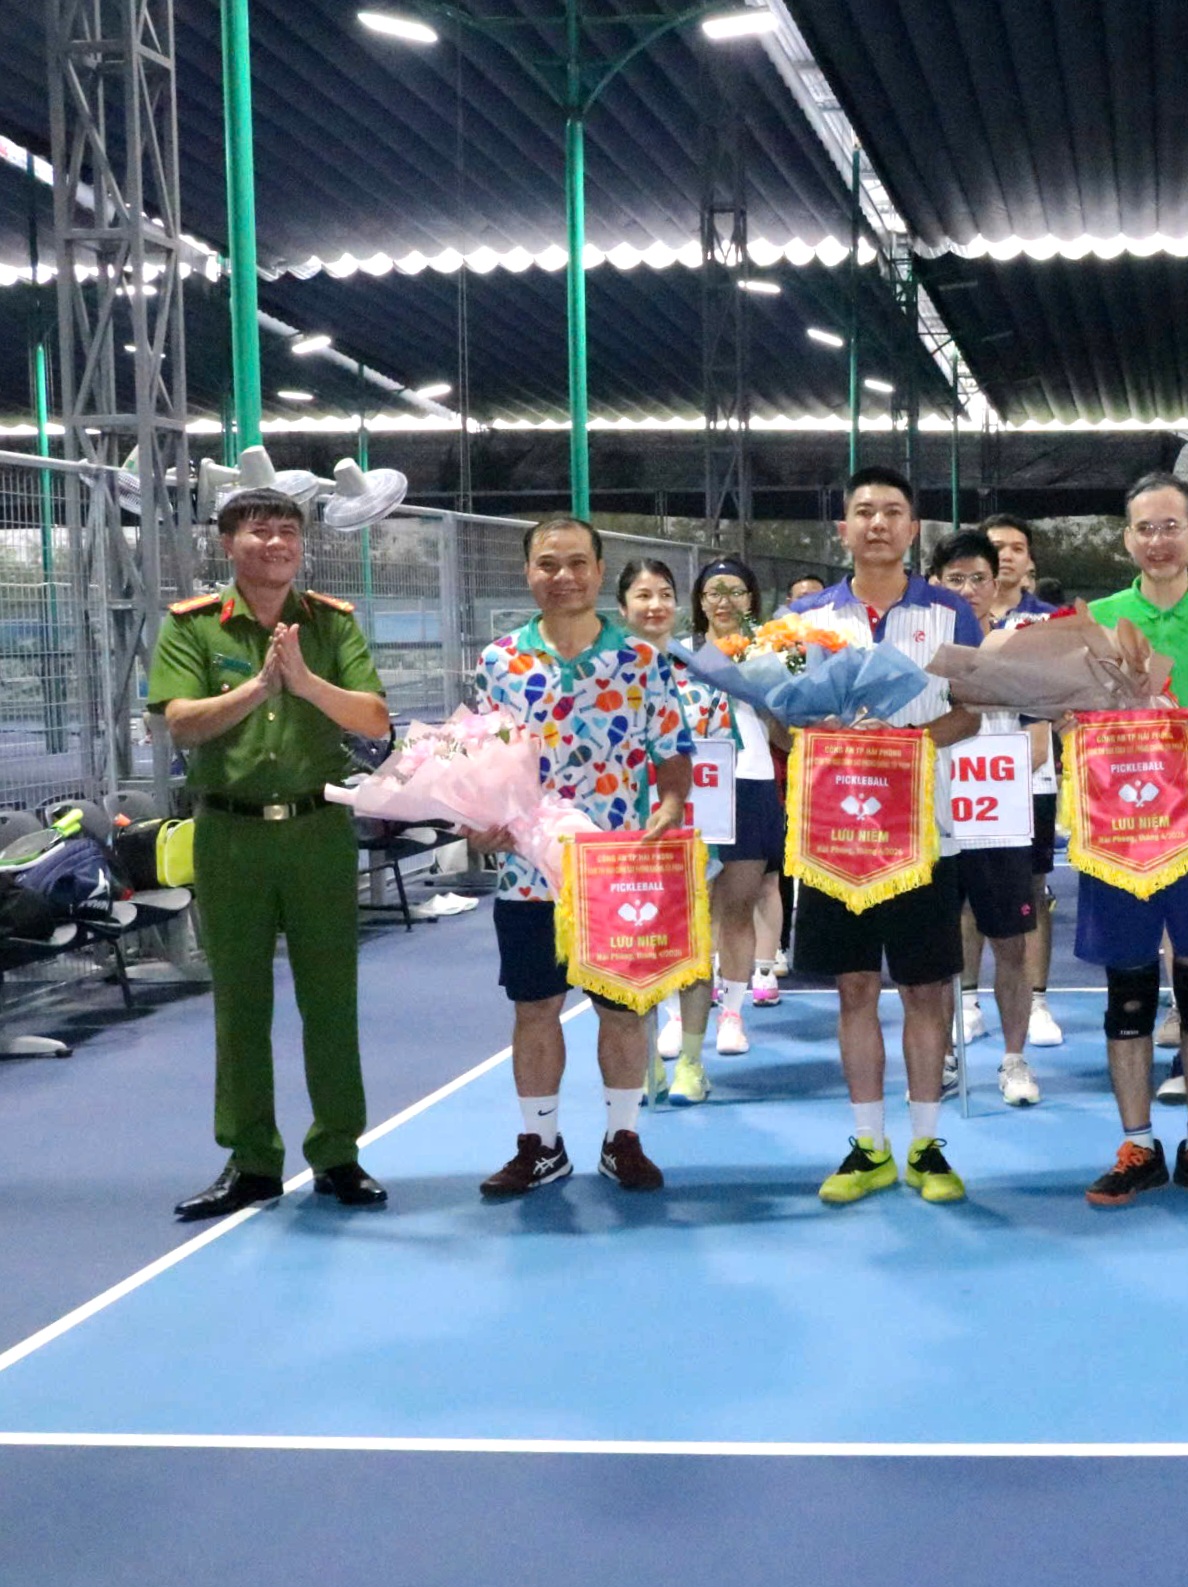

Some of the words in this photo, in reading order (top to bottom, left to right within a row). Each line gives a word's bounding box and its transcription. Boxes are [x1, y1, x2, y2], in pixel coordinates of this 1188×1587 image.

[1110, 761, 1164, 773] PICKLEBALL
[835, 775, 889, 787] PICKLEBALL
[1139, 814, 1170, 831] NIỆM
[858, 828, 889, 843] NIỆM
[610, 881, 664, 893] PICKLEBALL
[637, 932, 668, 949] NIỆM
